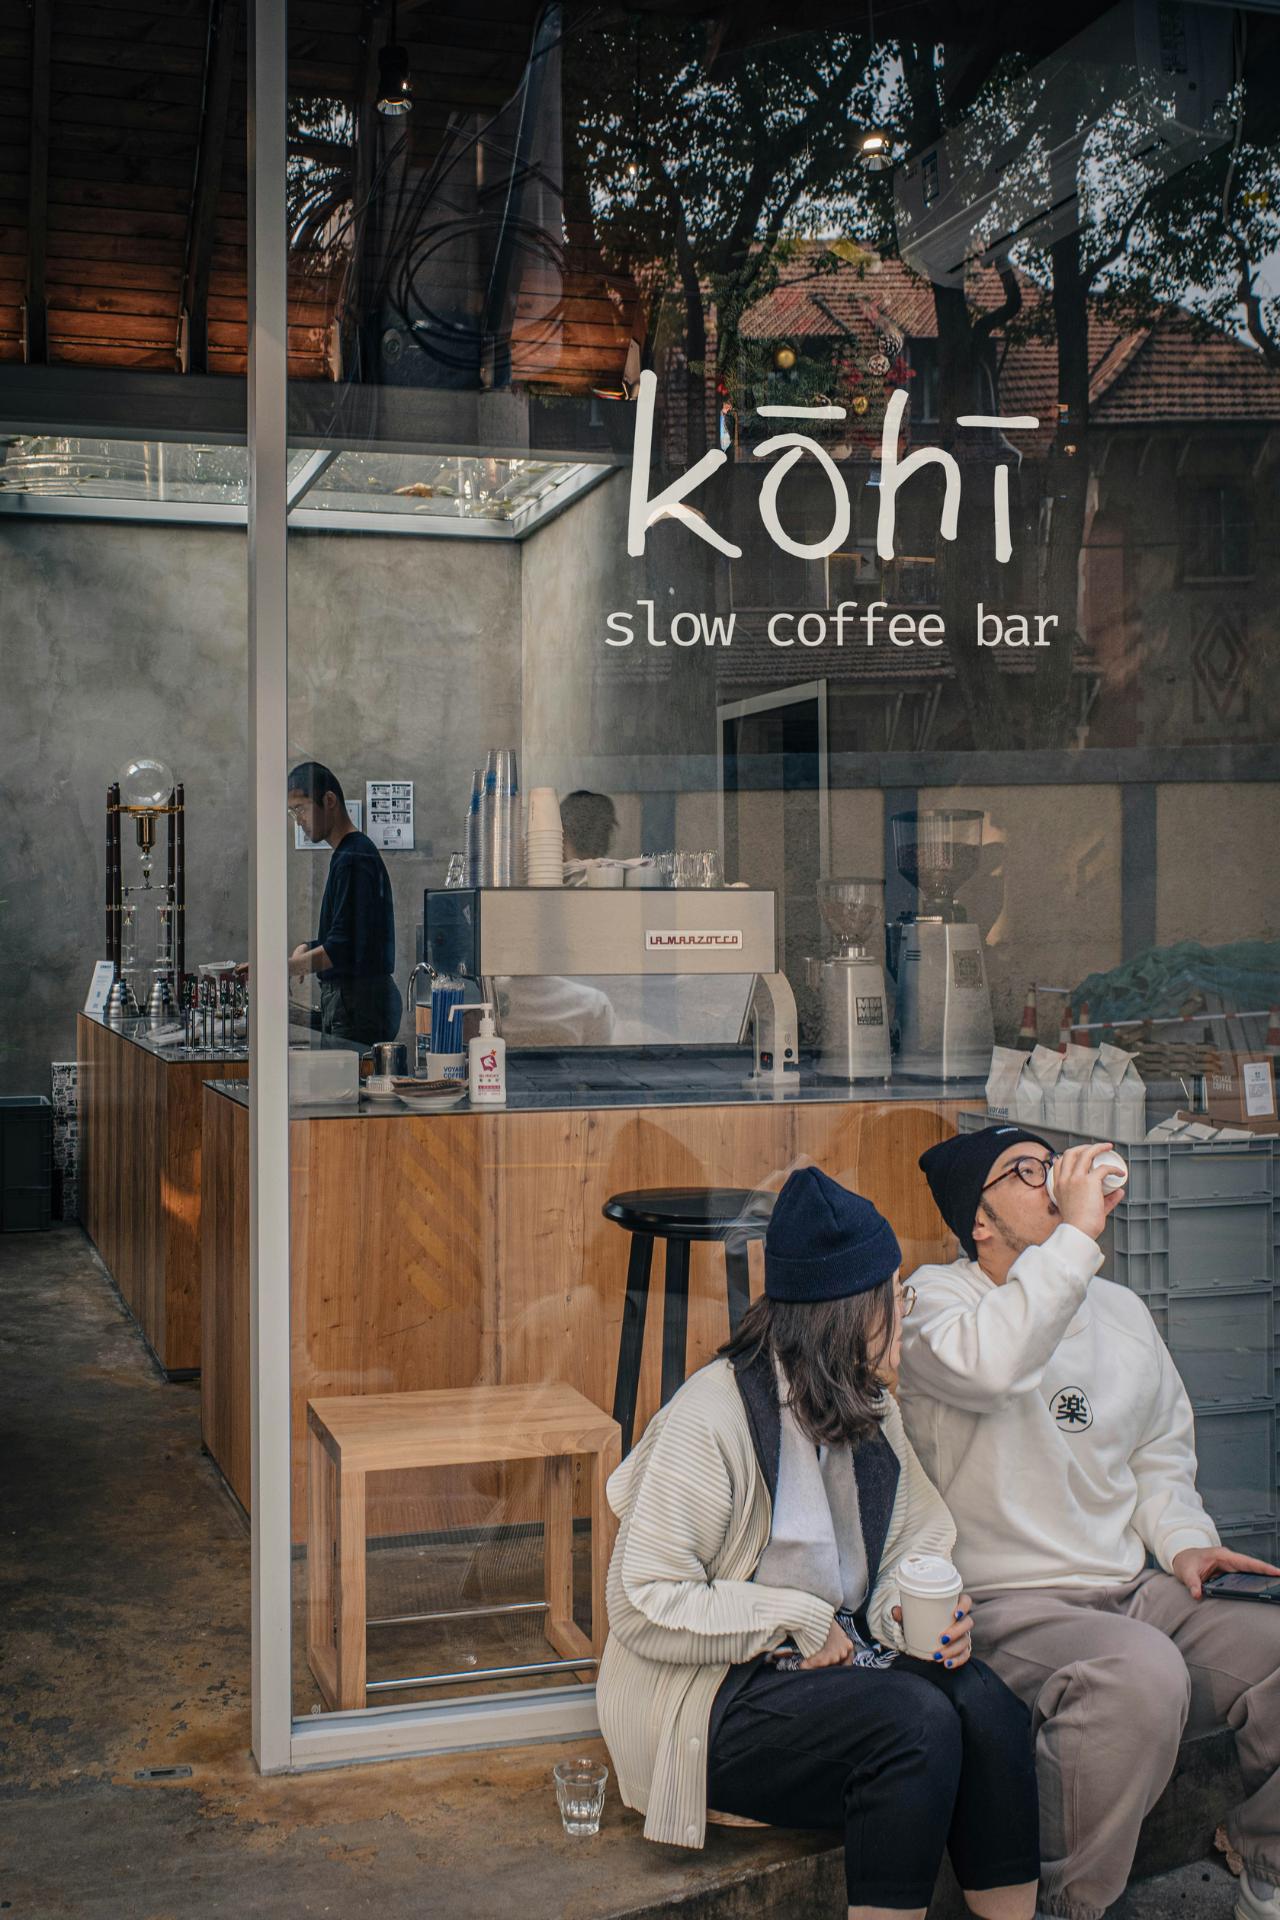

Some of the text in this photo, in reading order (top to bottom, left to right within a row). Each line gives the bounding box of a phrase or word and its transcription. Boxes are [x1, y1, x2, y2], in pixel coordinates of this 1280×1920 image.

[604, 600, 1060, 647] slow coffee bar
[1055, 1394, 1087, 1424] 楽
